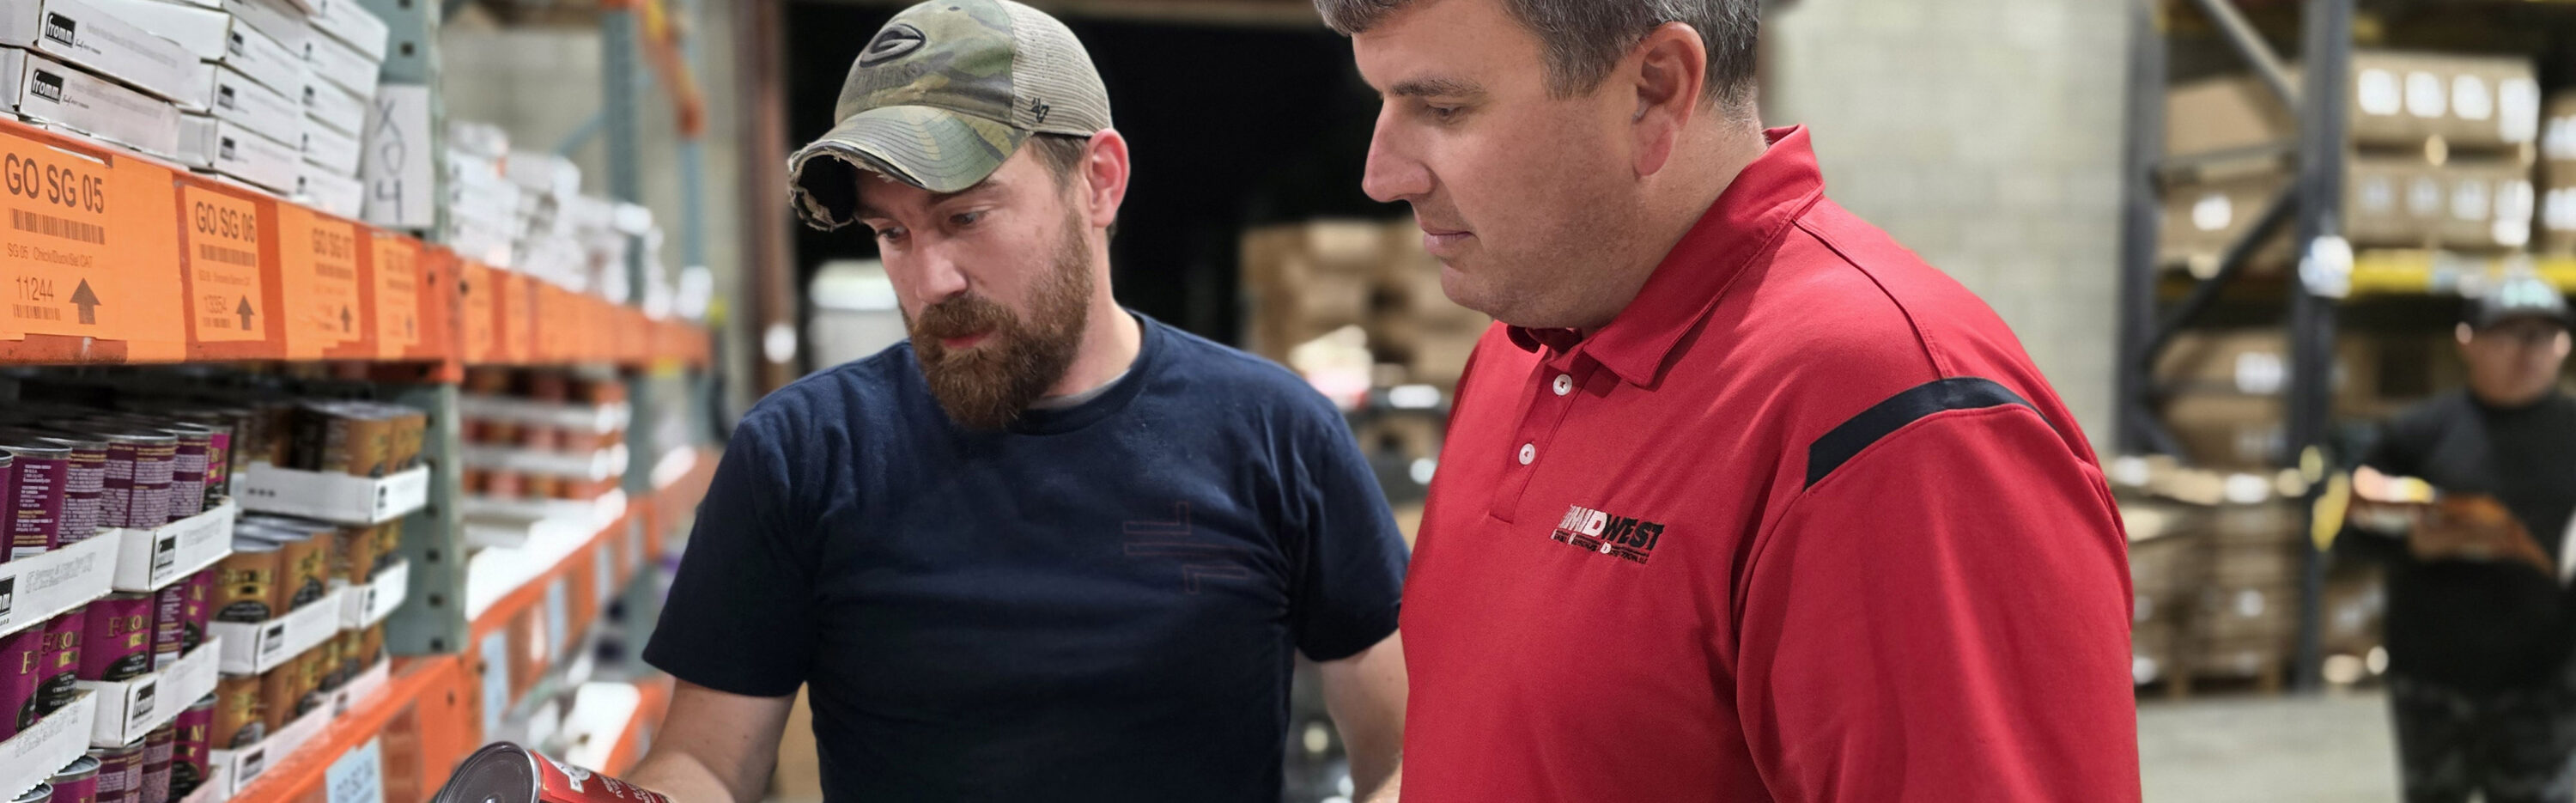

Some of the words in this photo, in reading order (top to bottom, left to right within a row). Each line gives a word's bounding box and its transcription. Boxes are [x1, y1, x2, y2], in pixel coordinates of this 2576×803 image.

[46, 14, 74, 42] fromm
[31, 70, 60, 98] fromm
[4, 153, 39, 199] GO
[46, 164, 76, 208] SG
[82, 173, 104, 214] 05
[196, 201, 216, 235] GO
[220, 207, 239, 240] SG
[242, 213, 256, 243] 06
[15, 275, 54, 301] 11244
[1558, 503, 1665, 551] MIDWEST
